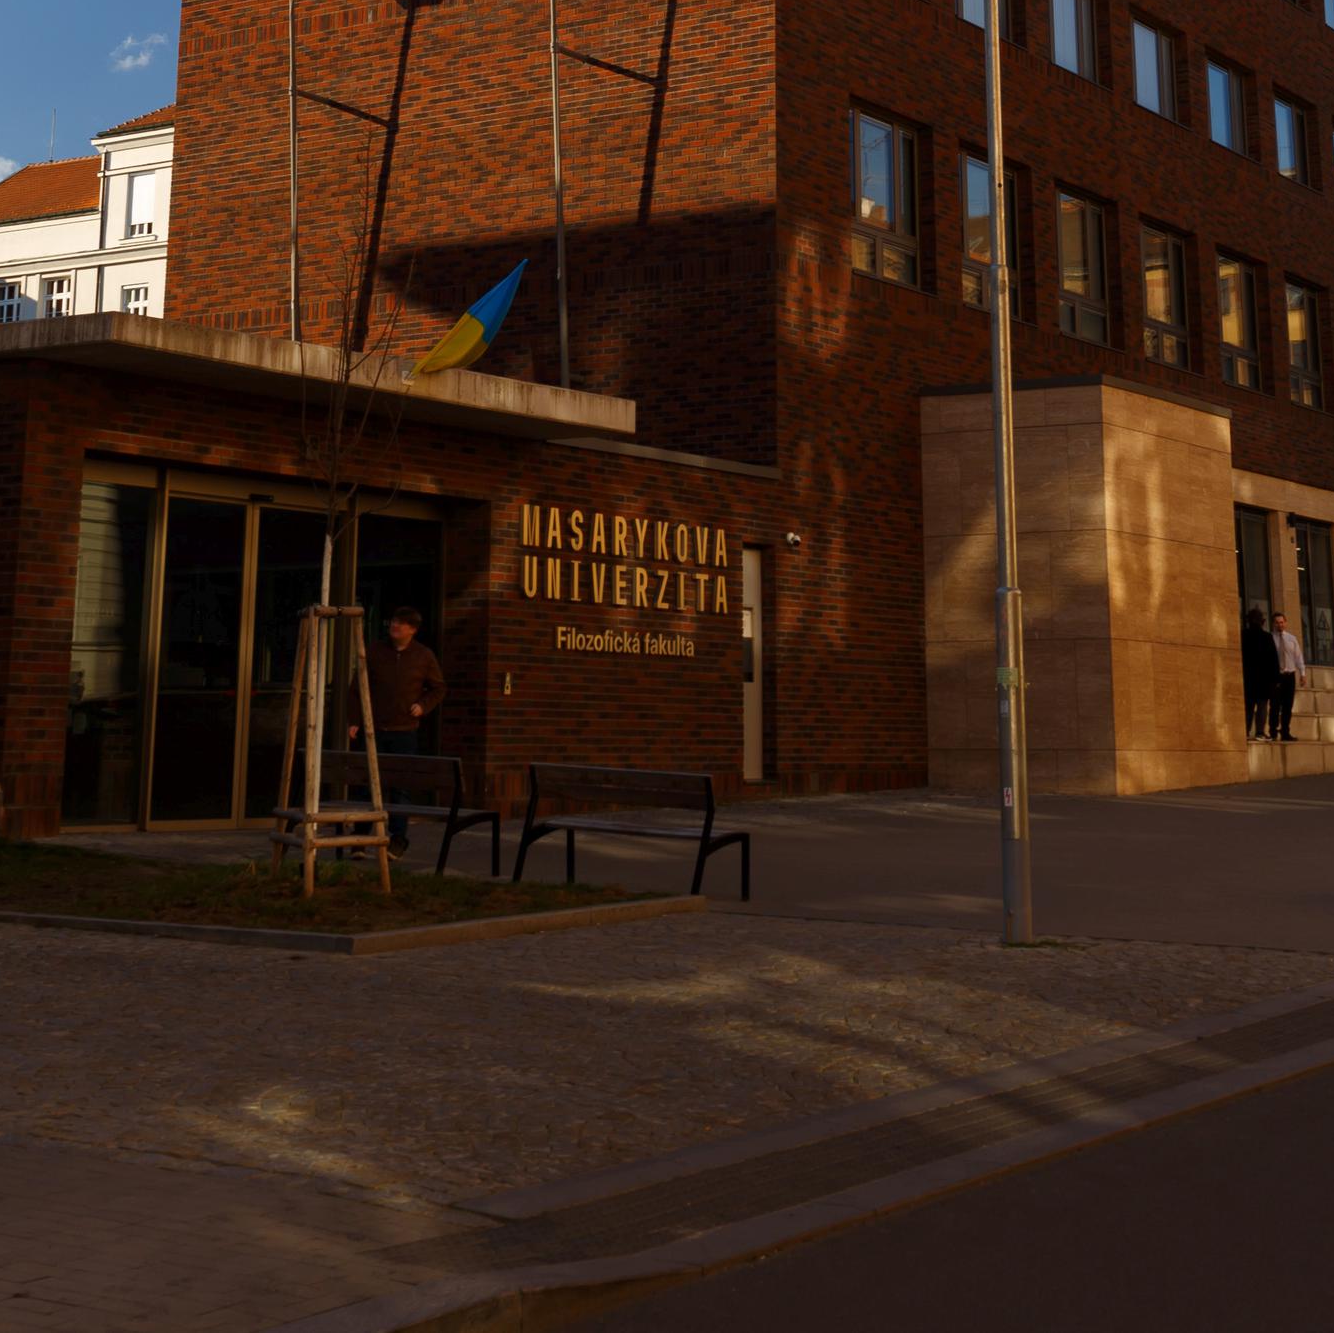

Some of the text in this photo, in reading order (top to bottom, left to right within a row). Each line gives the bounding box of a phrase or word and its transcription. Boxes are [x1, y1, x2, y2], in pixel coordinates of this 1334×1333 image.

[520, 504, 728, 567] MASARYKOVA
[522, 556, 728, 614] UNIVERZITA
[556, 626, 695, 657] Filozofická fakulta
